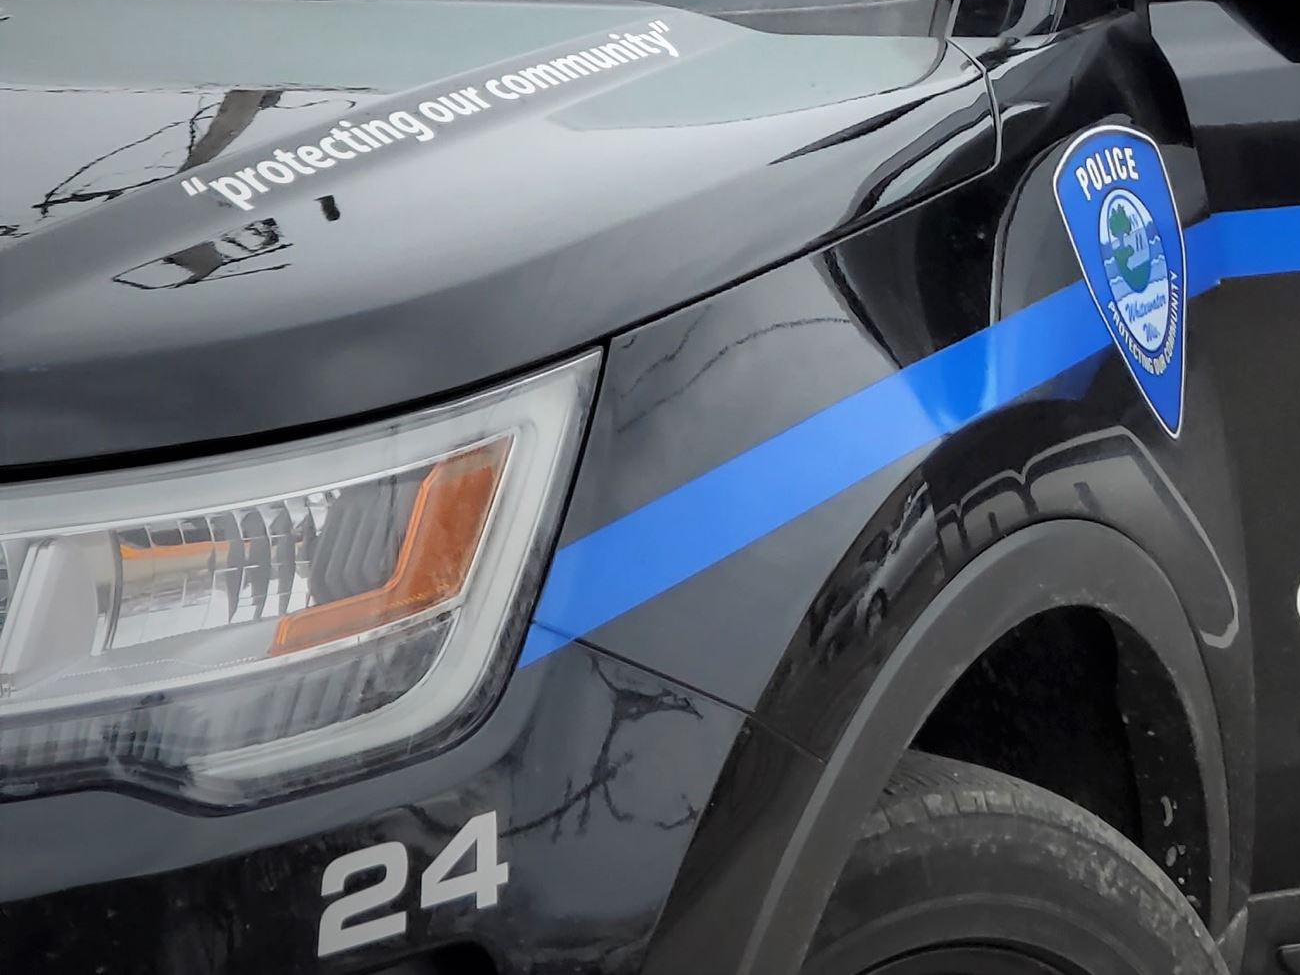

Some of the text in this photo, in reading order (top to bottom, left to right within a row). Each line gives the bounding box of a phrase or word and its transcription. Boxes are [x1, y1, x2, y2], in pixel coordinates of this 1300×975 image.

[418, 83, 492, 124] our
[1075, 146, 1139, 201] POLICE
[317, 810, 509, 957] 24
